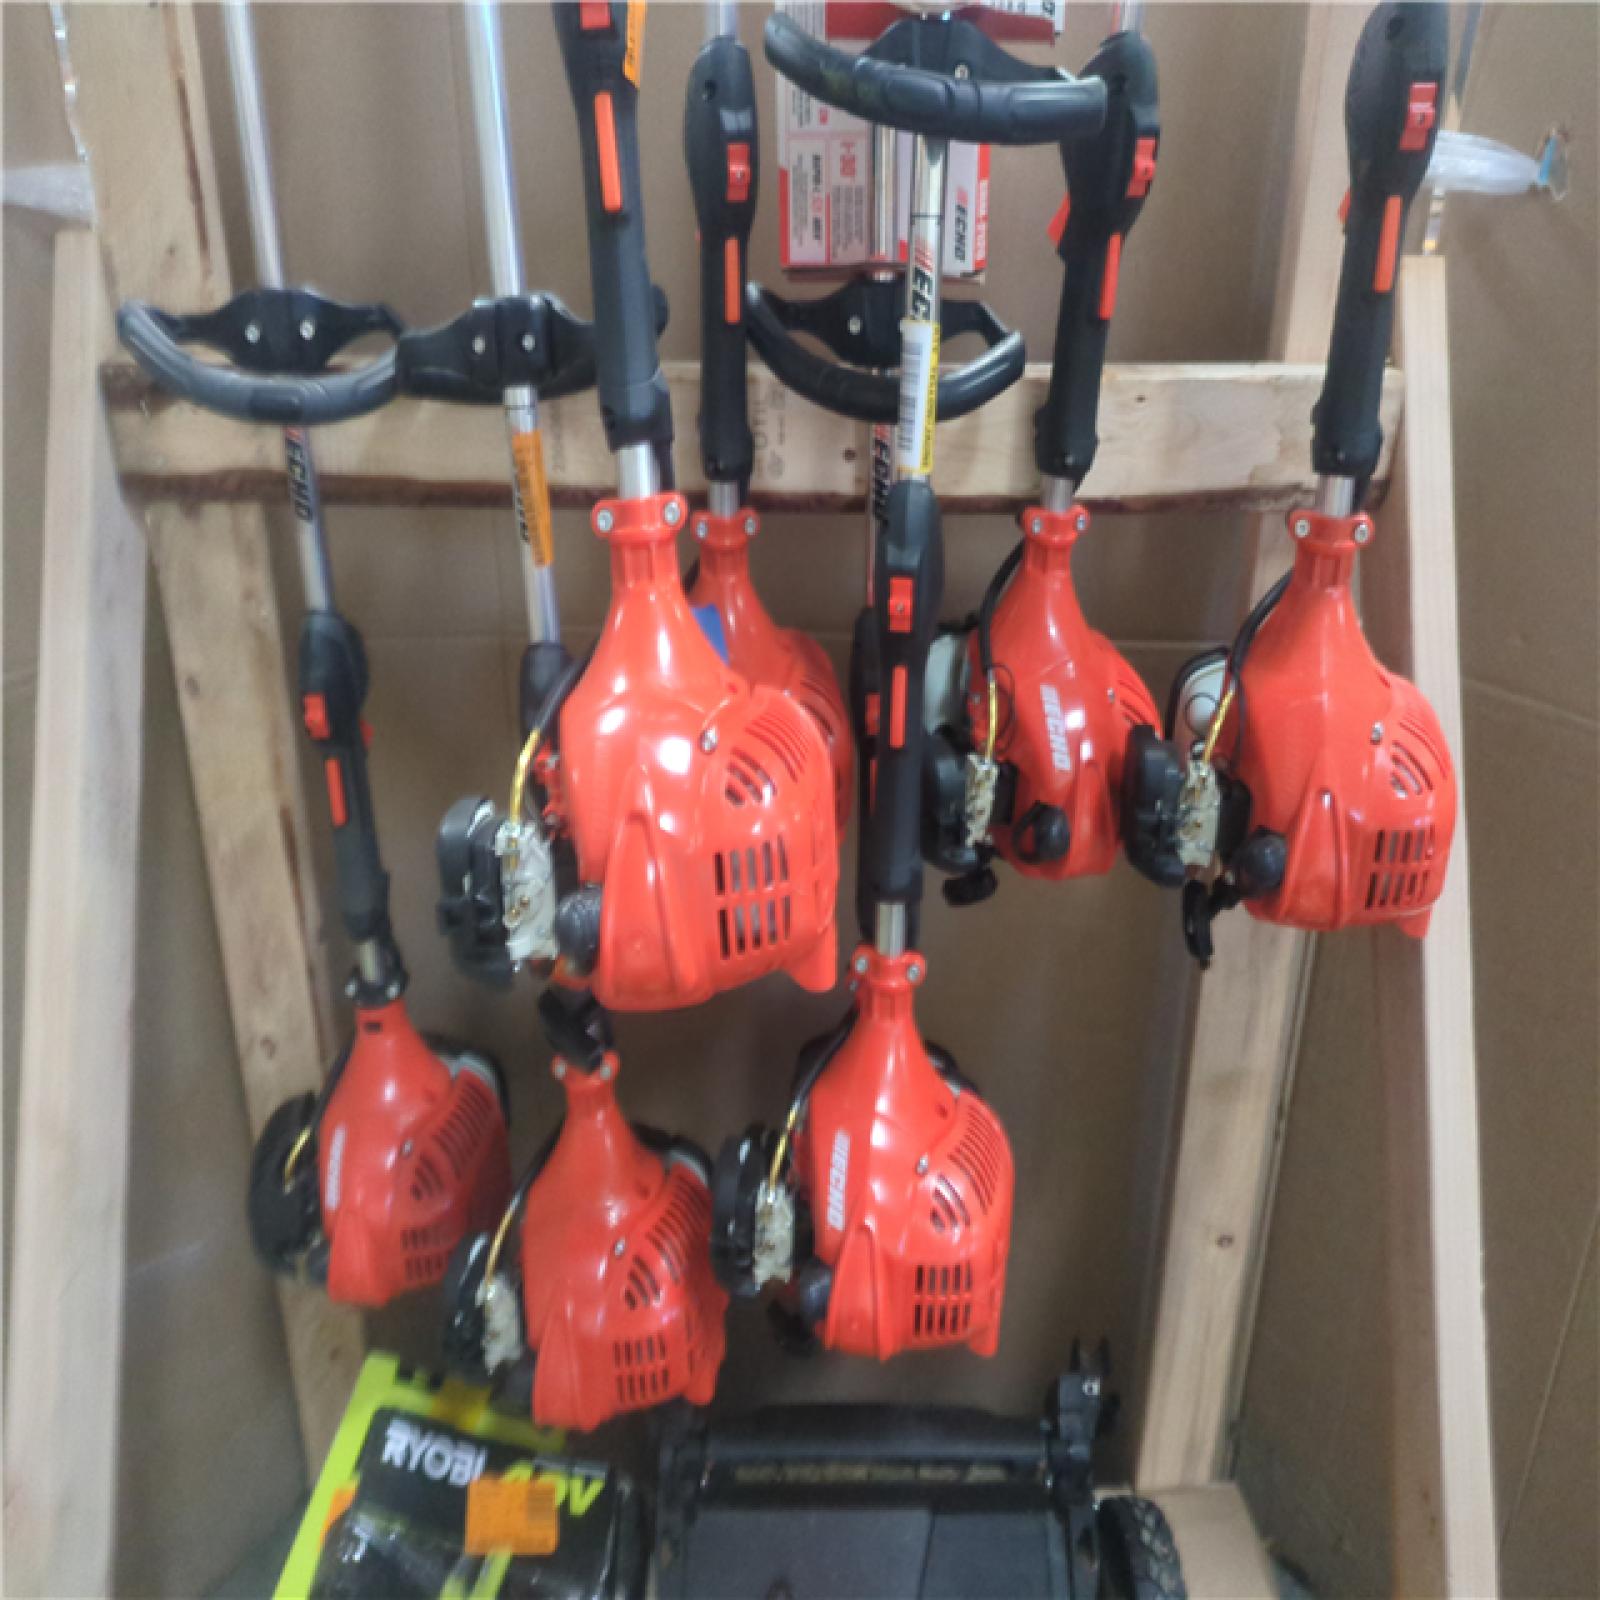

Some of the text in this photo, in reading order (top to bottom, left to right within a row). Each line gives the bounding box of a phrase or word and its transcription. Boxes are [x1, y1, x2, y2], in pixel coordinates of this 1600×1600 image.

[954, 203, 969, 262] ECHO
[286, 437, 312, 520] ECHO
[380, 1418, 488, 1487] RYOBI
